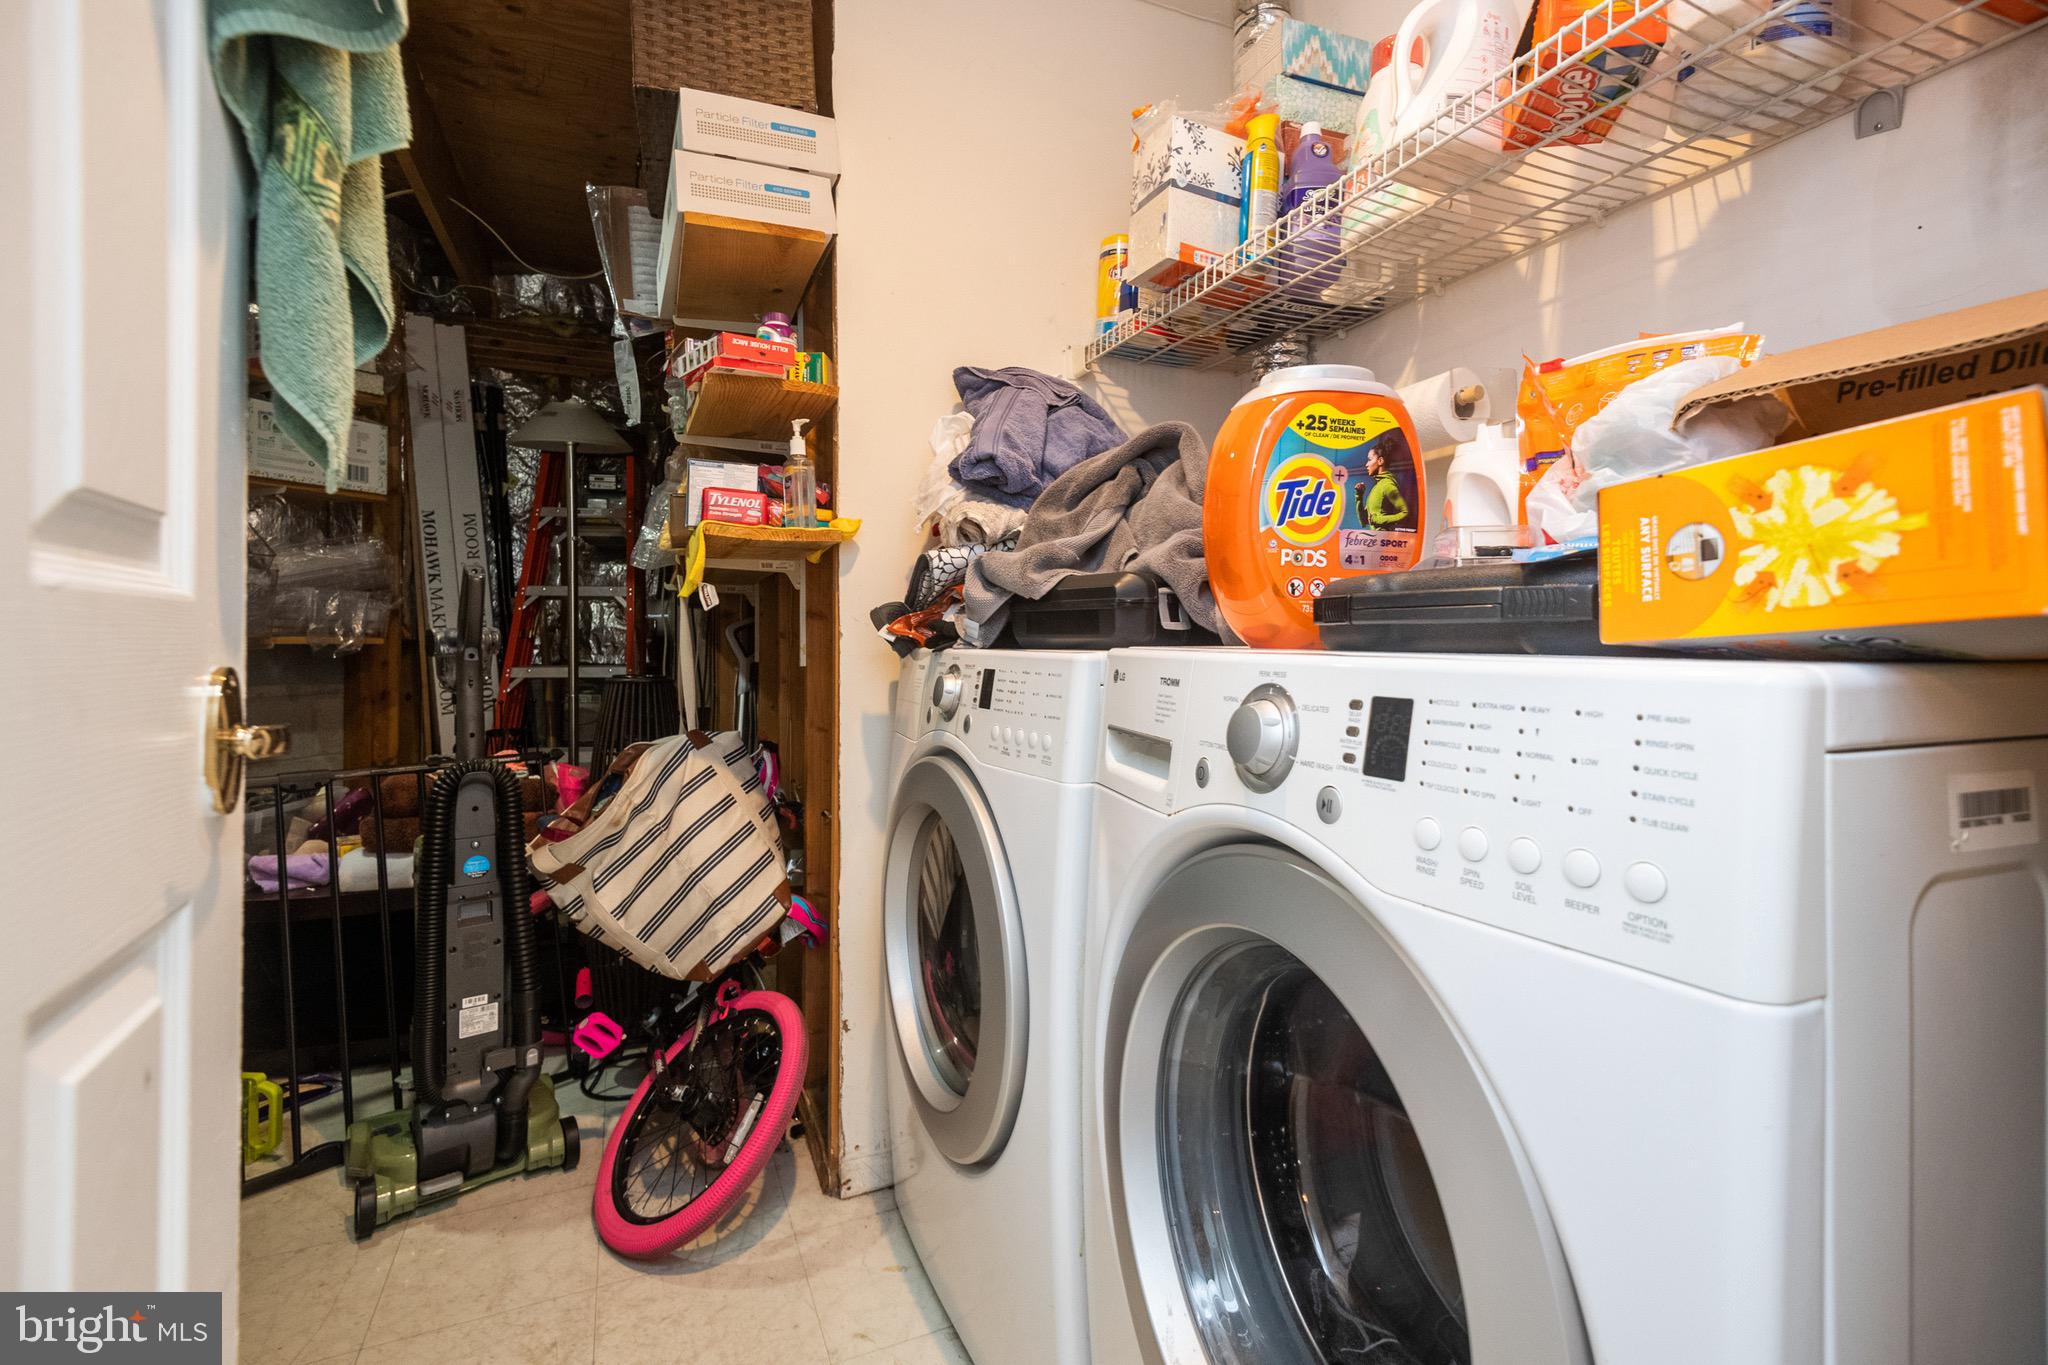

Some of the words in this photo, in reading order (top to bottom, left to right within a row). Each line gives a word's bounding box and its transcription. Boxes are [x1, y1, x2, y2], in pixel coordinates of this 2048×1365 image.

[695, 107, 740, 124] Particle
[741, 116, 769, 130] Filter
[689, 170, 734, 186] Particle
[735, 178, 763, 191] Filter
[732, 337, 748, 346] MICE
[750, 340, 770, 350] HOUSE
[1837, 354, 1980, 403] Pre-filled
[1296, 414, 1328, 431] +25
[1329, 417, 1356, 427] WEEKS
[1329, 426, 1366, 435] SEMAINES
[709, 492, 762, 509] TYLENOL
[1276, 477, 1337, 528] Tide
[463, 513, 481, 560] ROOM
[1640, 517, 1651, 543] ANY
[422, 509, 440, 583] MOHAWK
[1345, 532, 1378, 548] febreze
[1380, 539, 1408, 548] SPORT
[1280, 549, 1327, 568] PODS
[1612, 538, 1622, 585] TOUTES
[1602, 547, 1613, 608] SURFACES
[1640, 547, 1653, 602] SURFACE
[429, 587, 446, 631] MAK
[1160, 676, 1180, 687] TROMM
[1580, 758, 1599, 766] LOW
[1643, 766, 1669, 777] QUICK
[1671, 769, 1698, 781] CYCLE
[1462, 867, 1481, 879] SPIN
[1459, 877, 1485, 890] SPEED
[1514, 881, 1534, 894] SOIL
[1512, 891, 1537, 905] LEVEL
[1564, 898, 1601, 915] BEEPER
[1627, 911, 1669, 930] OPTION
